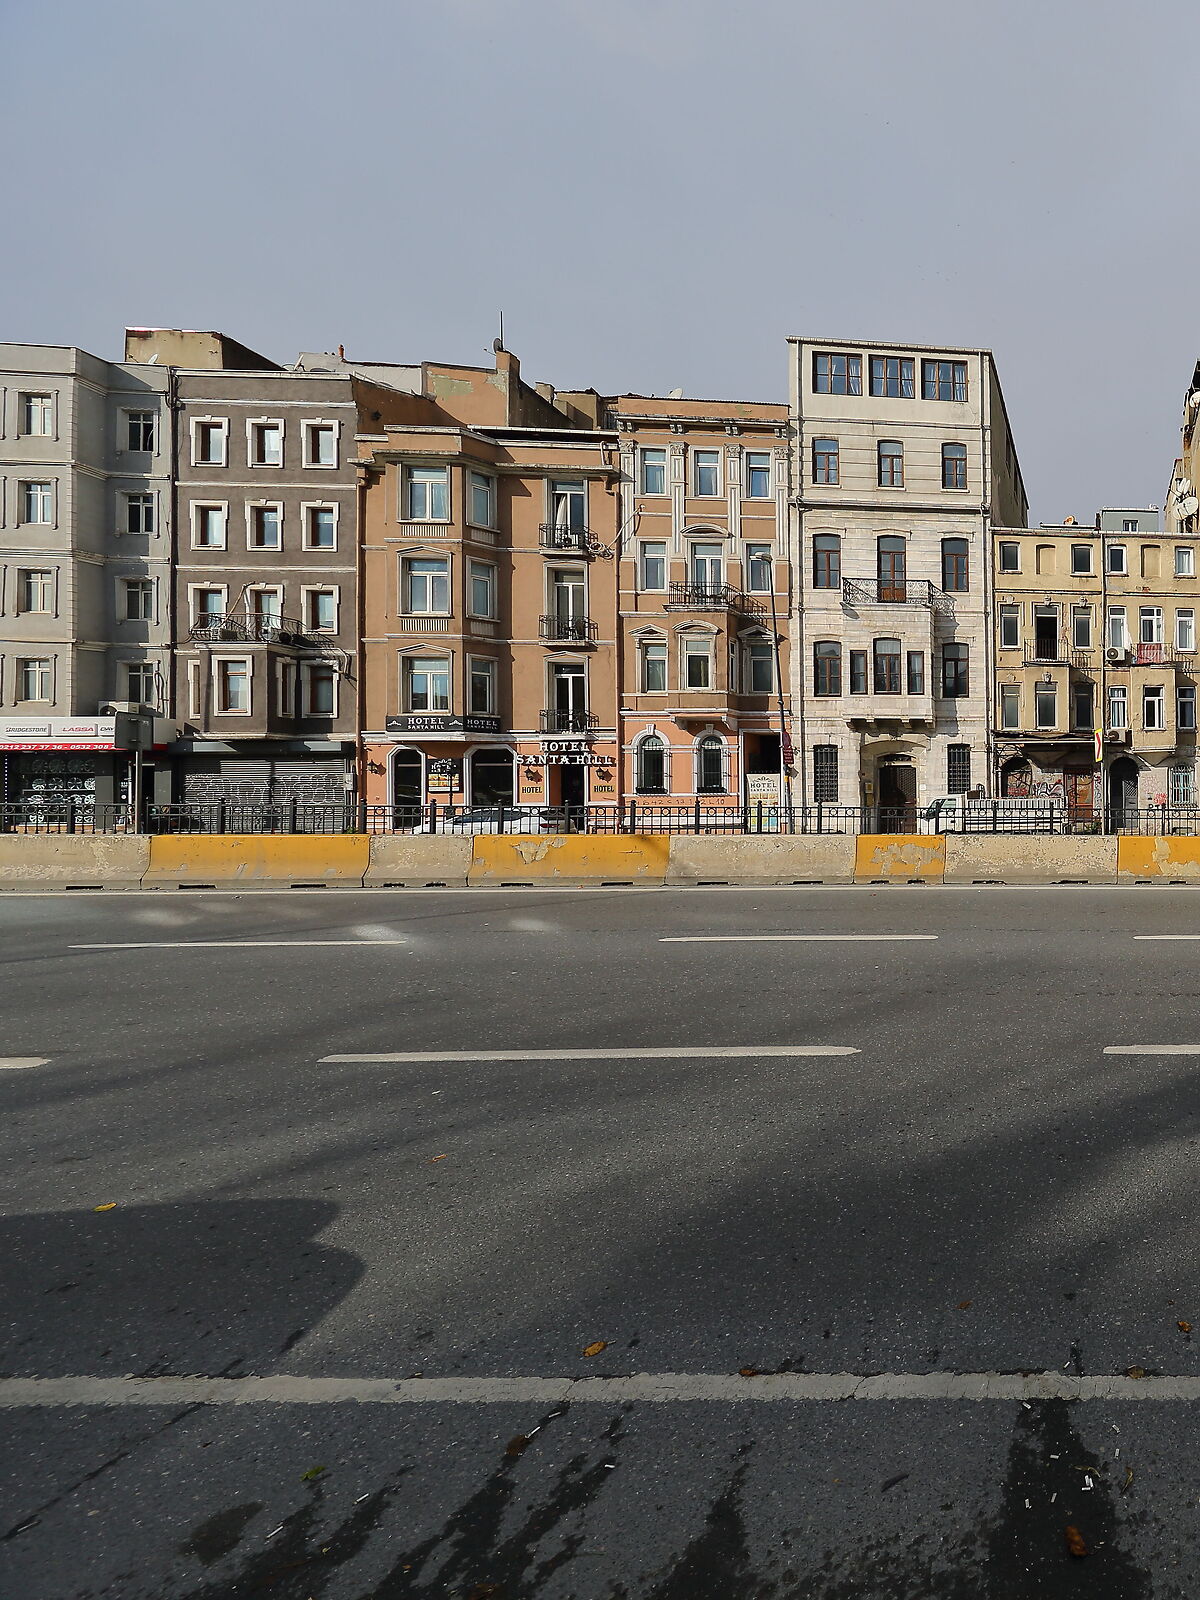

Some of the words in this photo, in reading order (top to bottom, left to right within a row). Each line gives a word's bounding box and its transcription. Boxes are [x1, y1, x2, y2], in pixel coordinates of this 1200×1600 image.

[539, 742, 590, 752] HOTEL
[516, 755, 570, 764] SANTA
[576, 754, 613, 764] HILL
